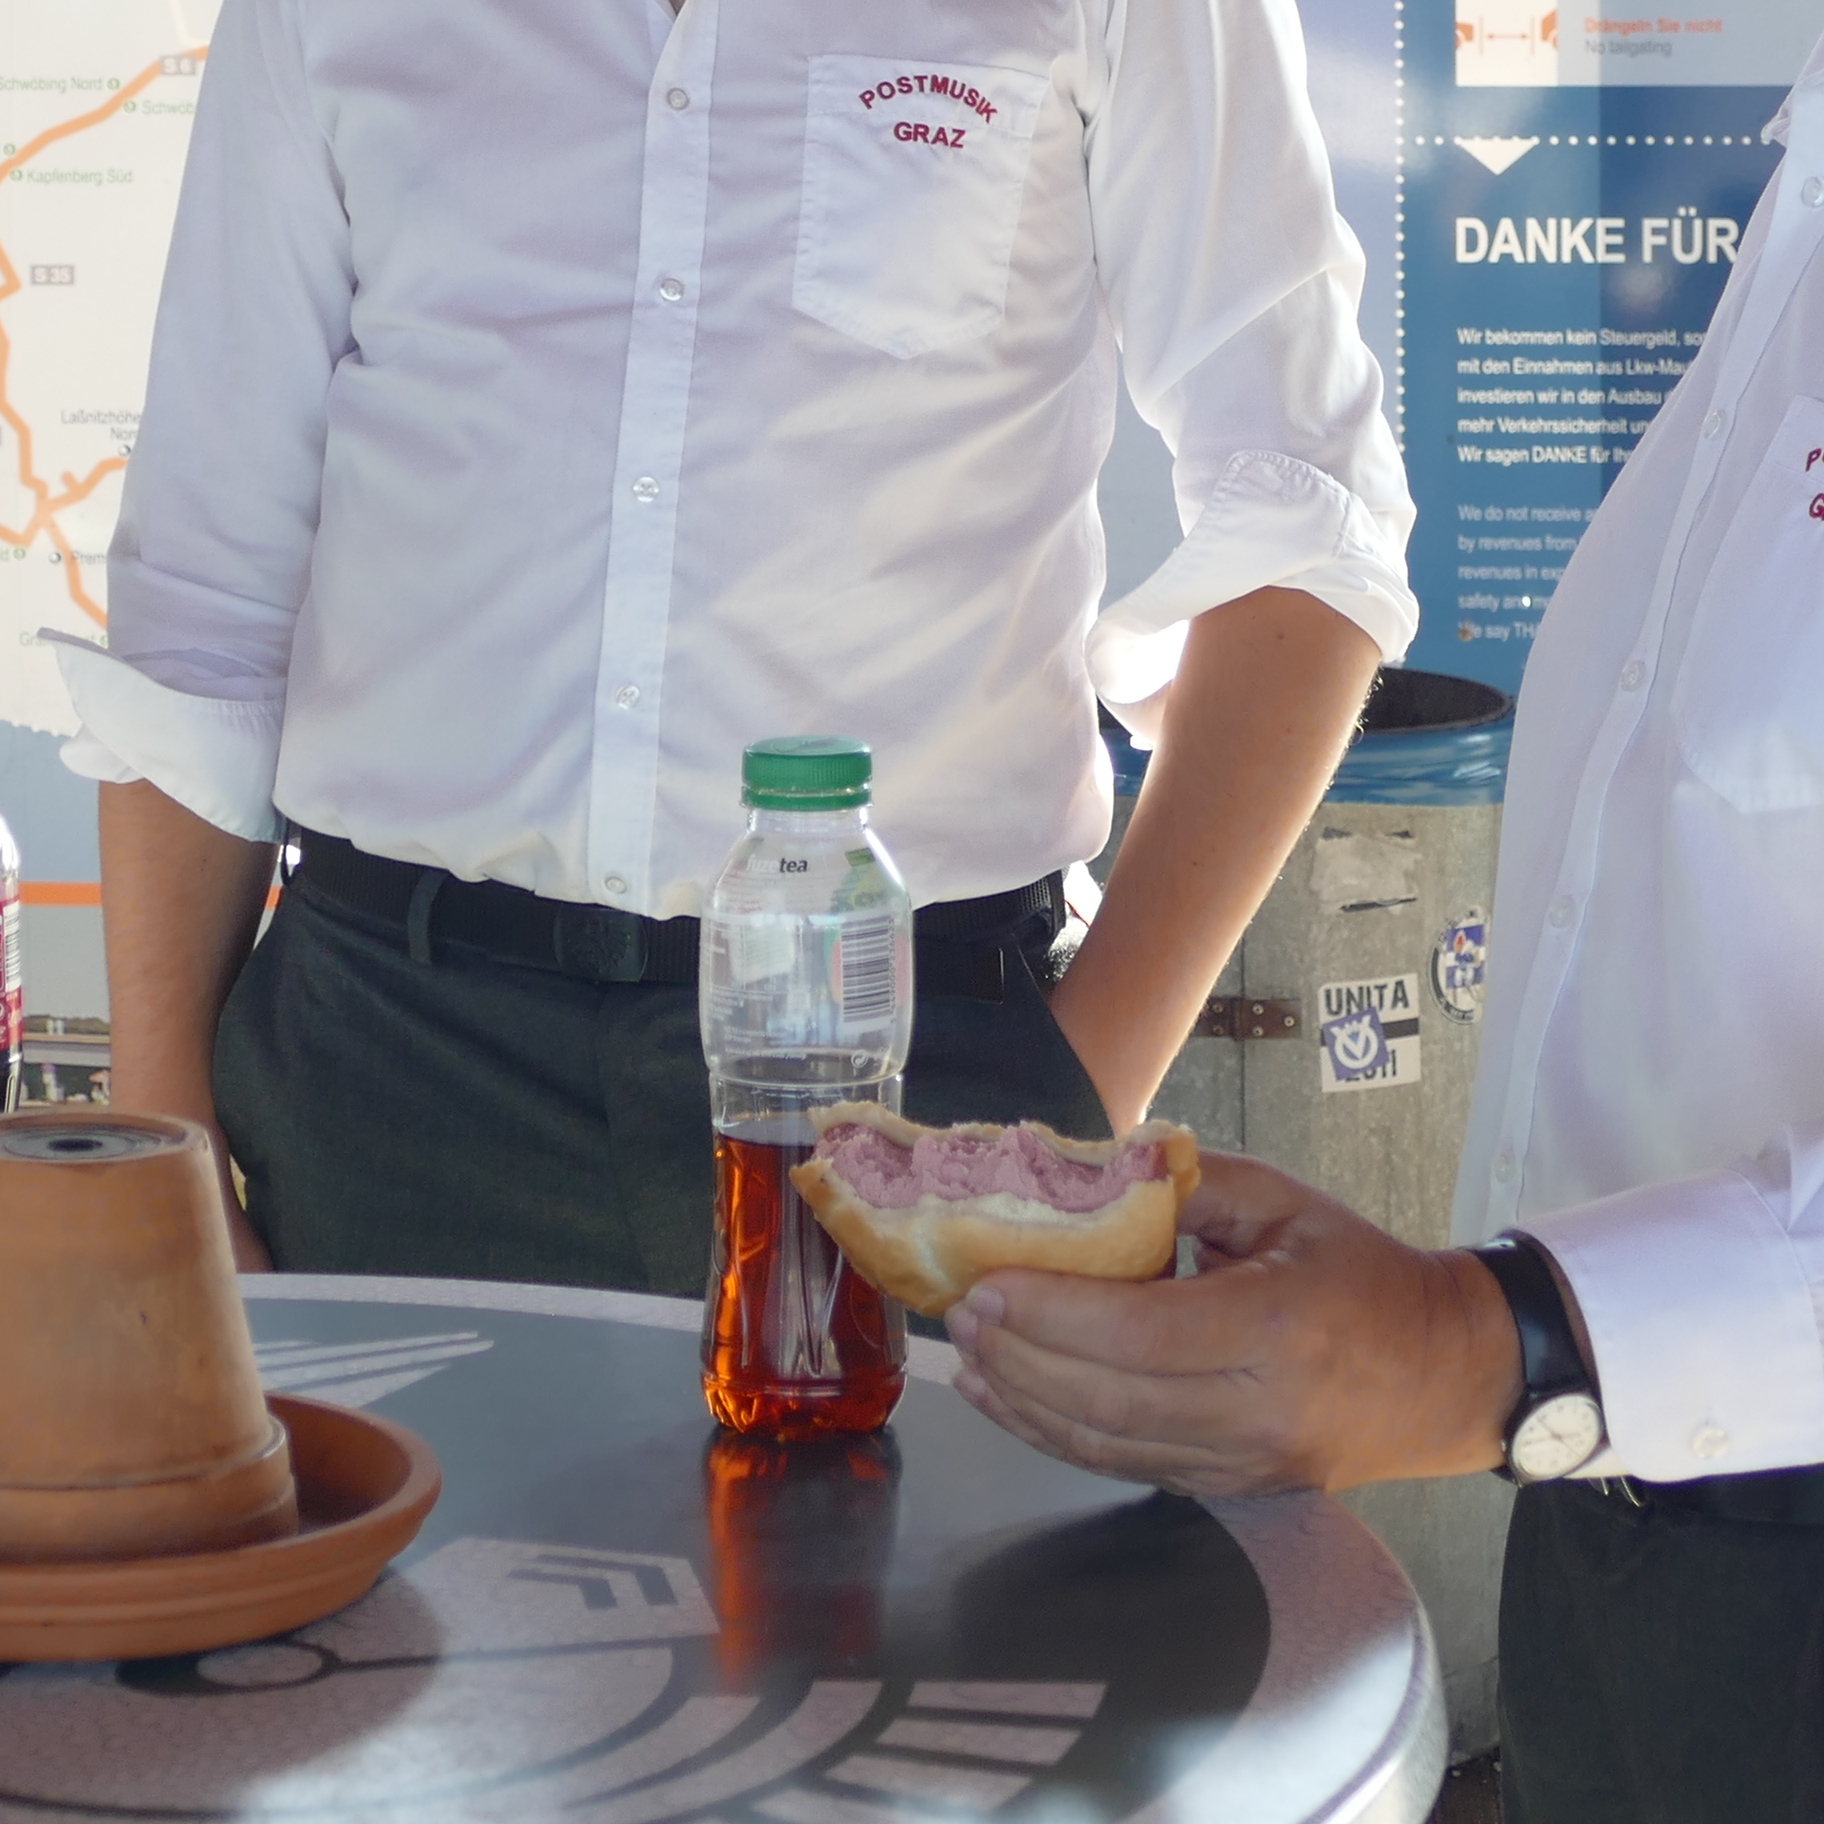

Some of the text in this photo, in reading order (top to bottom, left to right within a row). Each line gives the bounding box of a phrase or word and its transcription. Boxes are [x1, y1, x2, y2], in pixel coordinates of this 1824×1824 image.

[858, 73, 998, 123] POSTMUSIK
[893, 121, 966, 150] GRAZ
[1455, 207, 1739, 265] DANKE FÜR
[1456, 327, 1482, 345] Wir
[1484, 328, 1564, 346] bekommen
[1566, 328, 1597, 345] kein
[1457, 357, 1623, 375] mit den Einnahmen aus
[1457, 386, 1663, 405] investieren wir in den Ausbau
[1457, 417, 1495, 434] mehr
[1457, 445, 1611, 467] Wir sagen DANKE für
[1324, 979, 1409, 1017] UNITA
